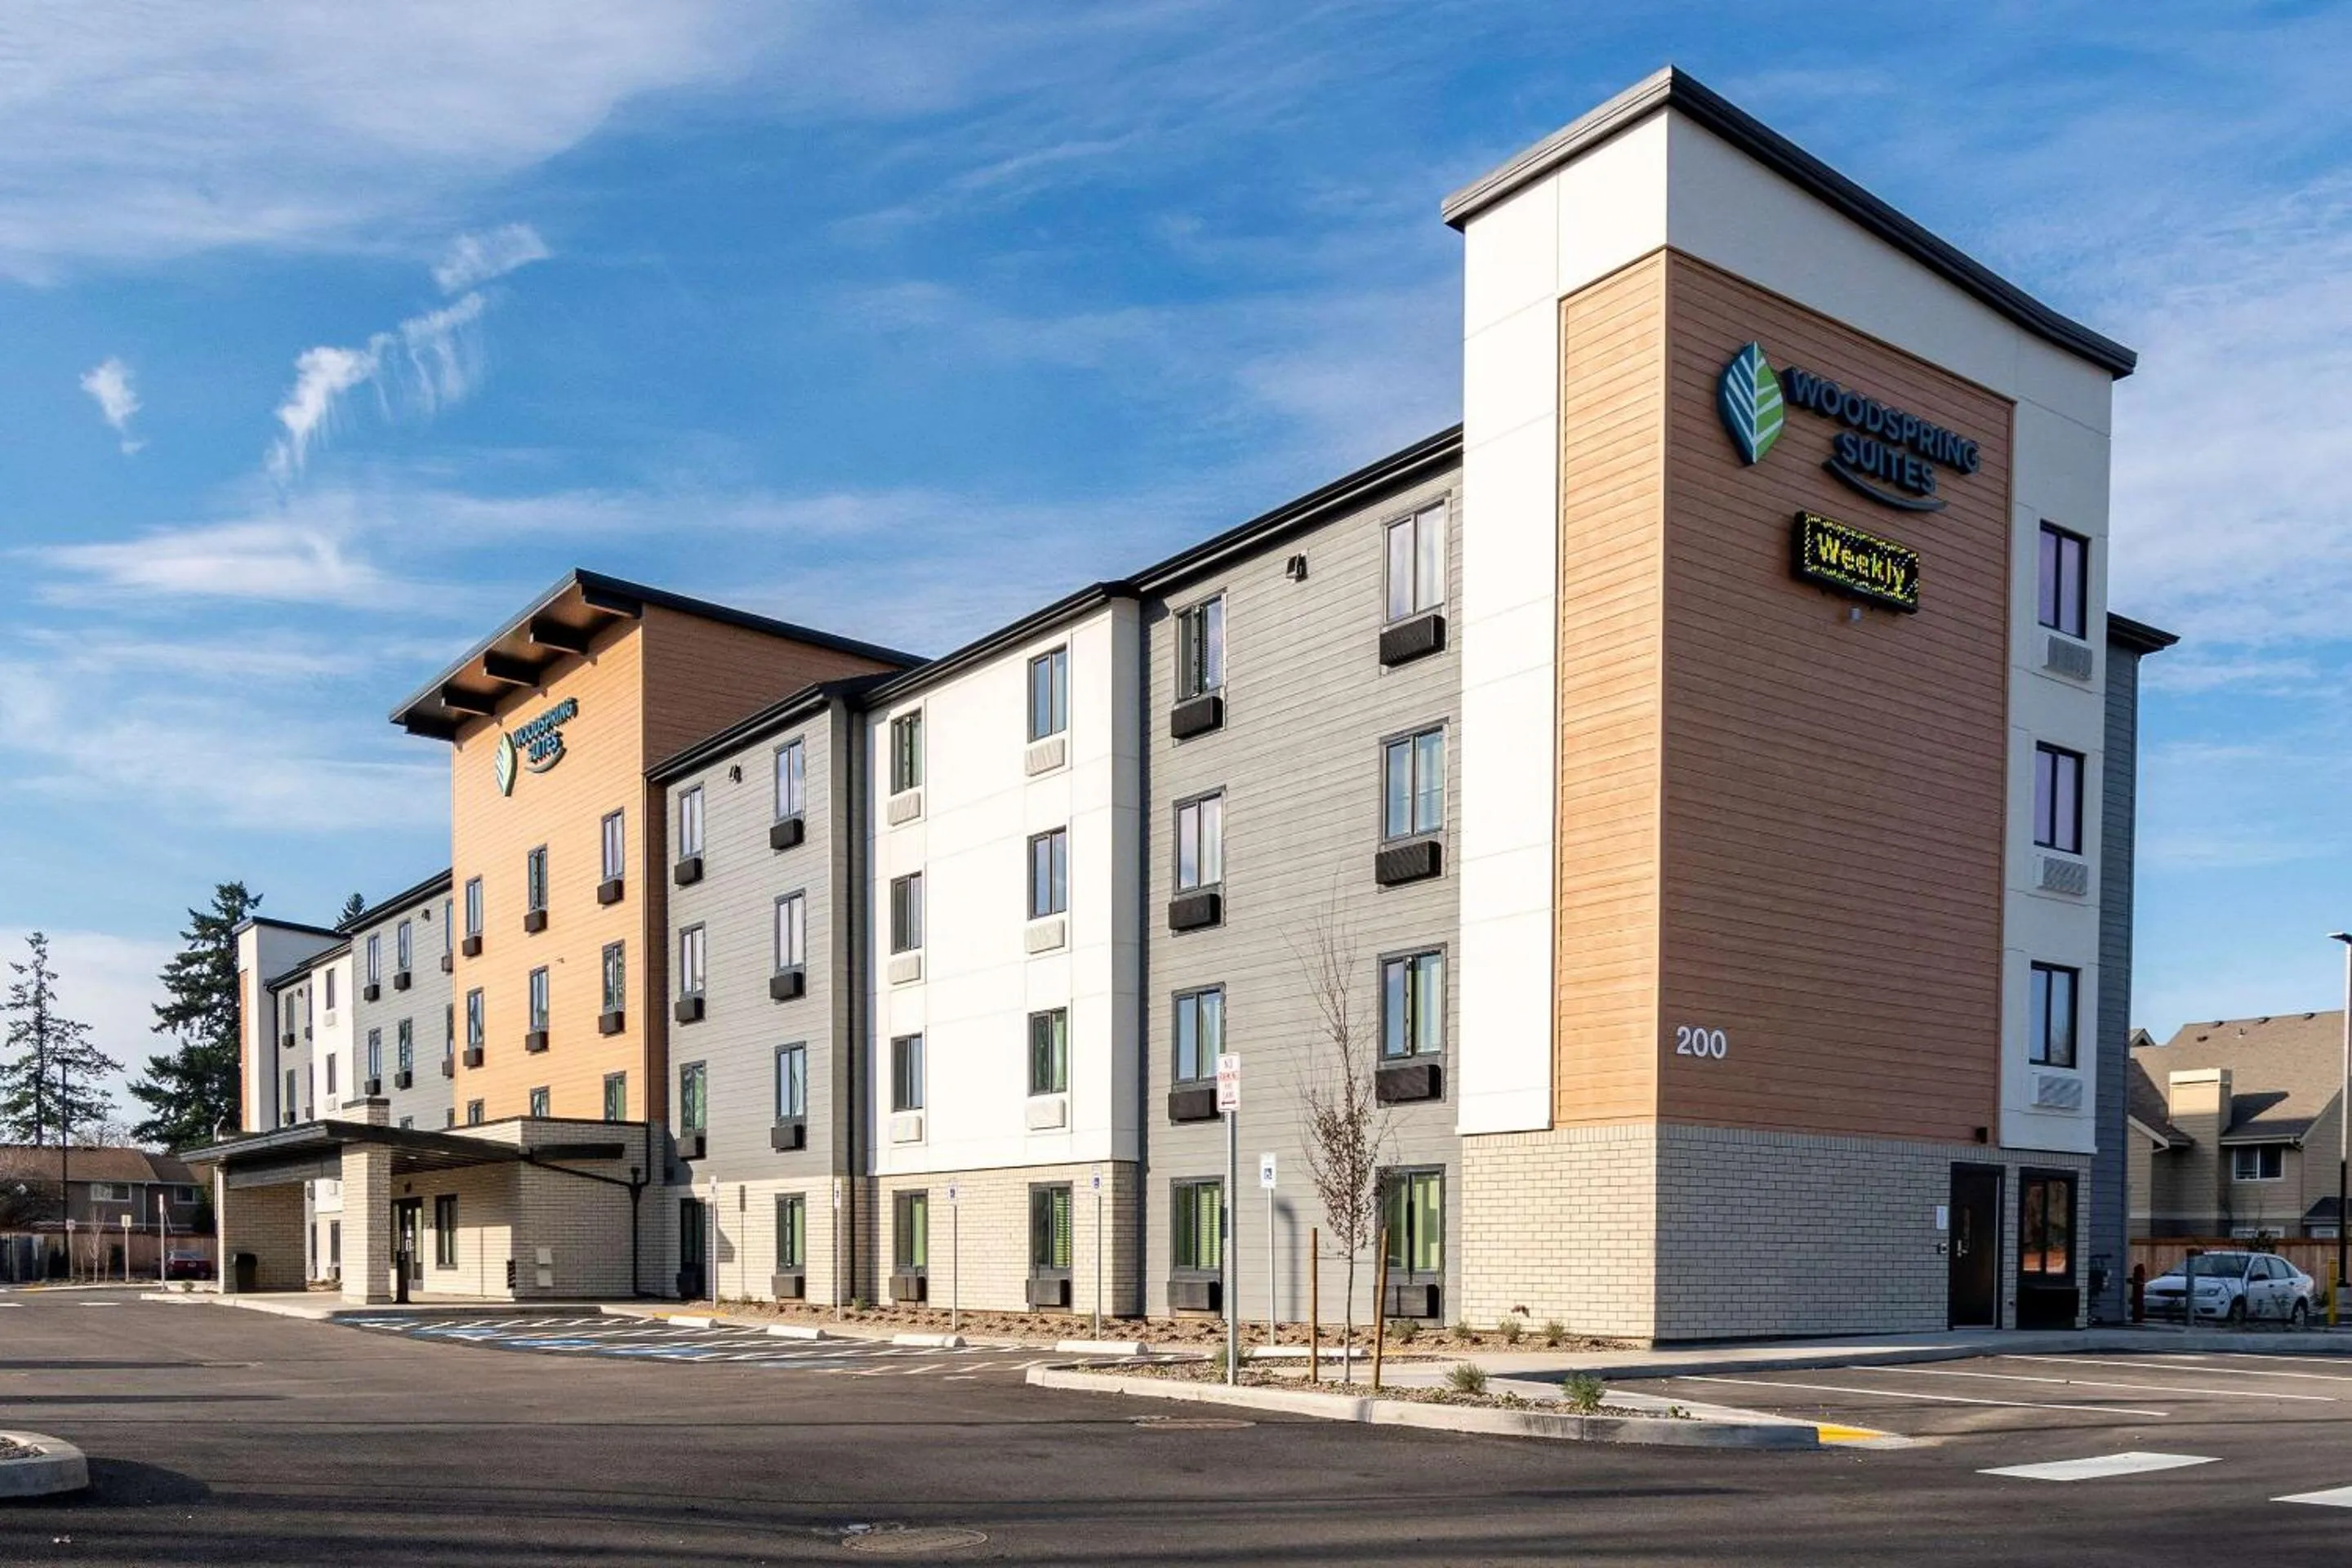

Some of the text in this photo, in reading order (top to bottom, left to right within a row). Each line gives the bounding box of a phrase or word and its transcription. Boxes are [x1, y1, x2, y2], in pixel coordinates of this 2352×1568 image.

[1782, 367, 1981, 474] WOODSPRING
[1833, 432, 1937, 495] SUITES
[1816, 532, 1906, 593] Weekly
[1676, 1026, 1727, 1059] 200
